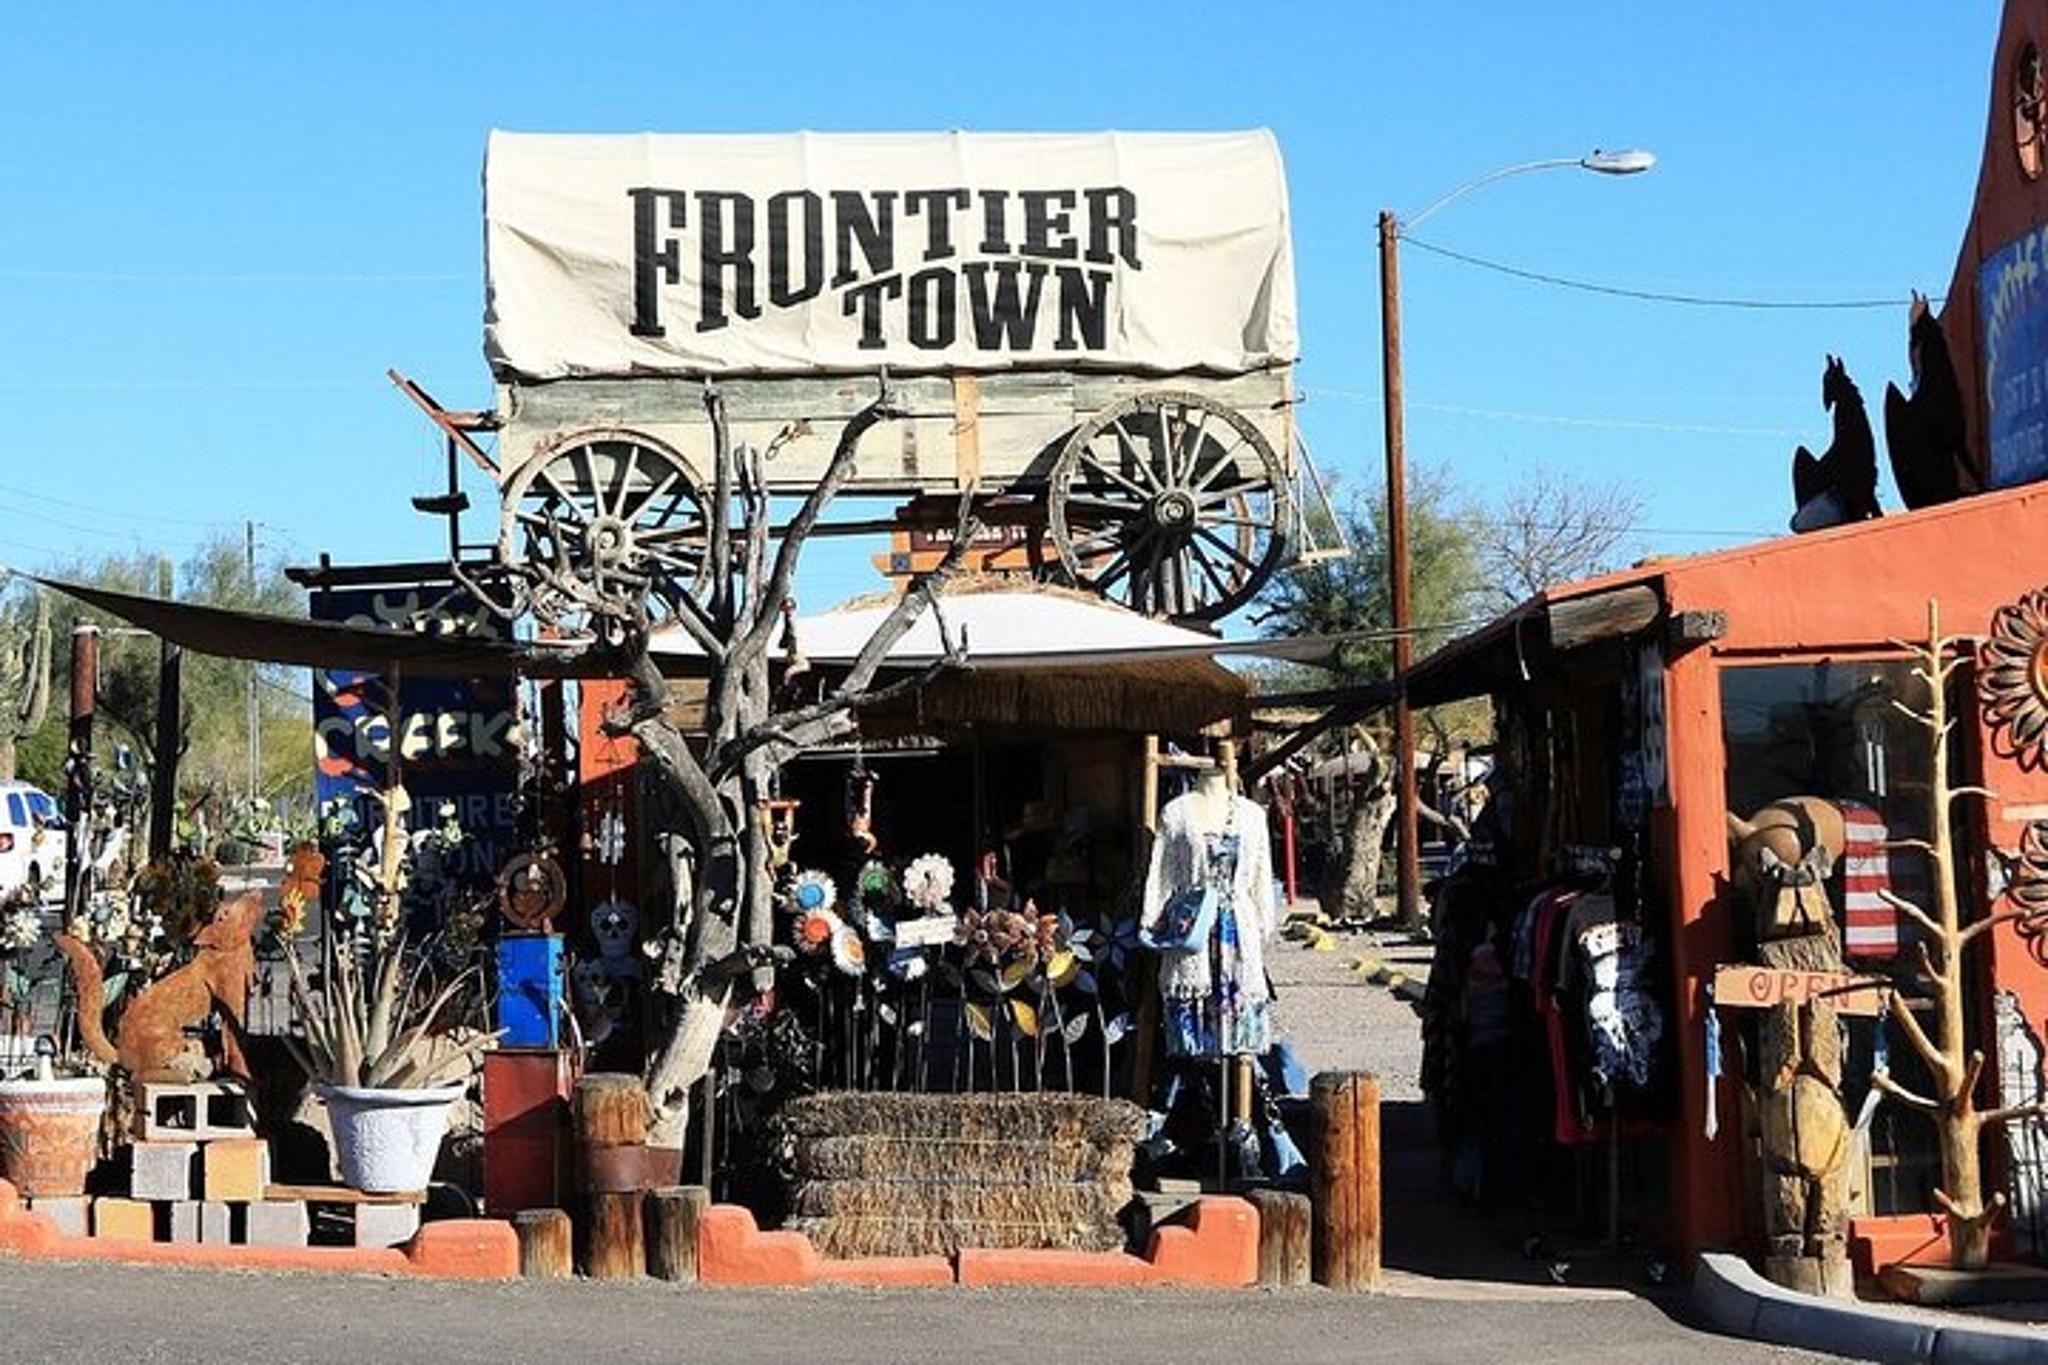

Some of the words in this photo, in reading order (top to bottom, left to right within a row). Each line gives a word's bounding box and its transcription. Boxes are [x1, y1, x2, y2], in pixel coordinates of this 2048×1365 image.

[627, 186, 1142, 337] FRONTIER
[842, 261, 1113, 351] TOWN
[316, 711, 512, 763] CREEK
[1749, 972, 1850, 1008] OPEN
